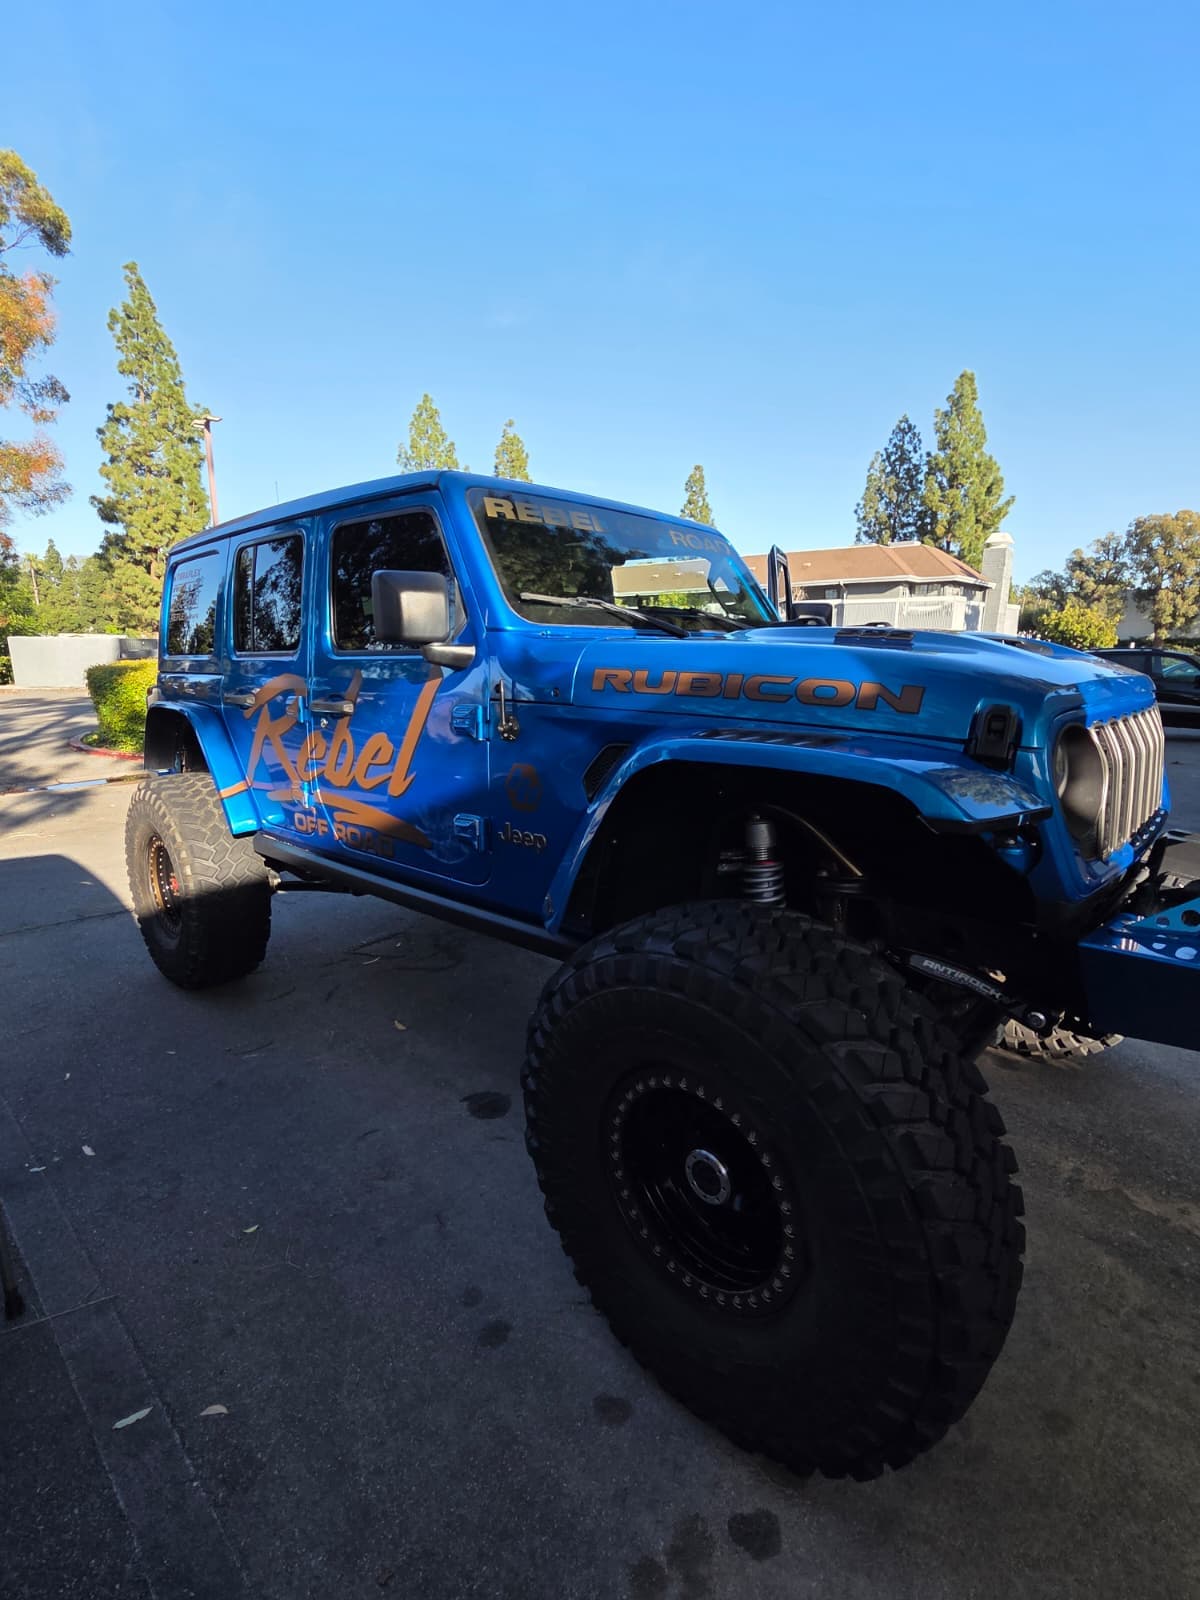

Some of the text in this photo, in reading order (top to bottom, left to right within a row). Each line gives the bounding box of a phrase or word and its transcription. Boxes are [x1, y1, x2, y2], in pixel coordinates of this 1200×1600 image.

[483, 497, 605, 532] REBEL
[591, 667, 926, 714] RUBICON
[243, 665, 443, 797] Rebel
[294, 812, 395, 857] OFF ROAD
[498, 822, 547, 854] Jeep
[922, 959, 1002, 1000] ANTIROCK
